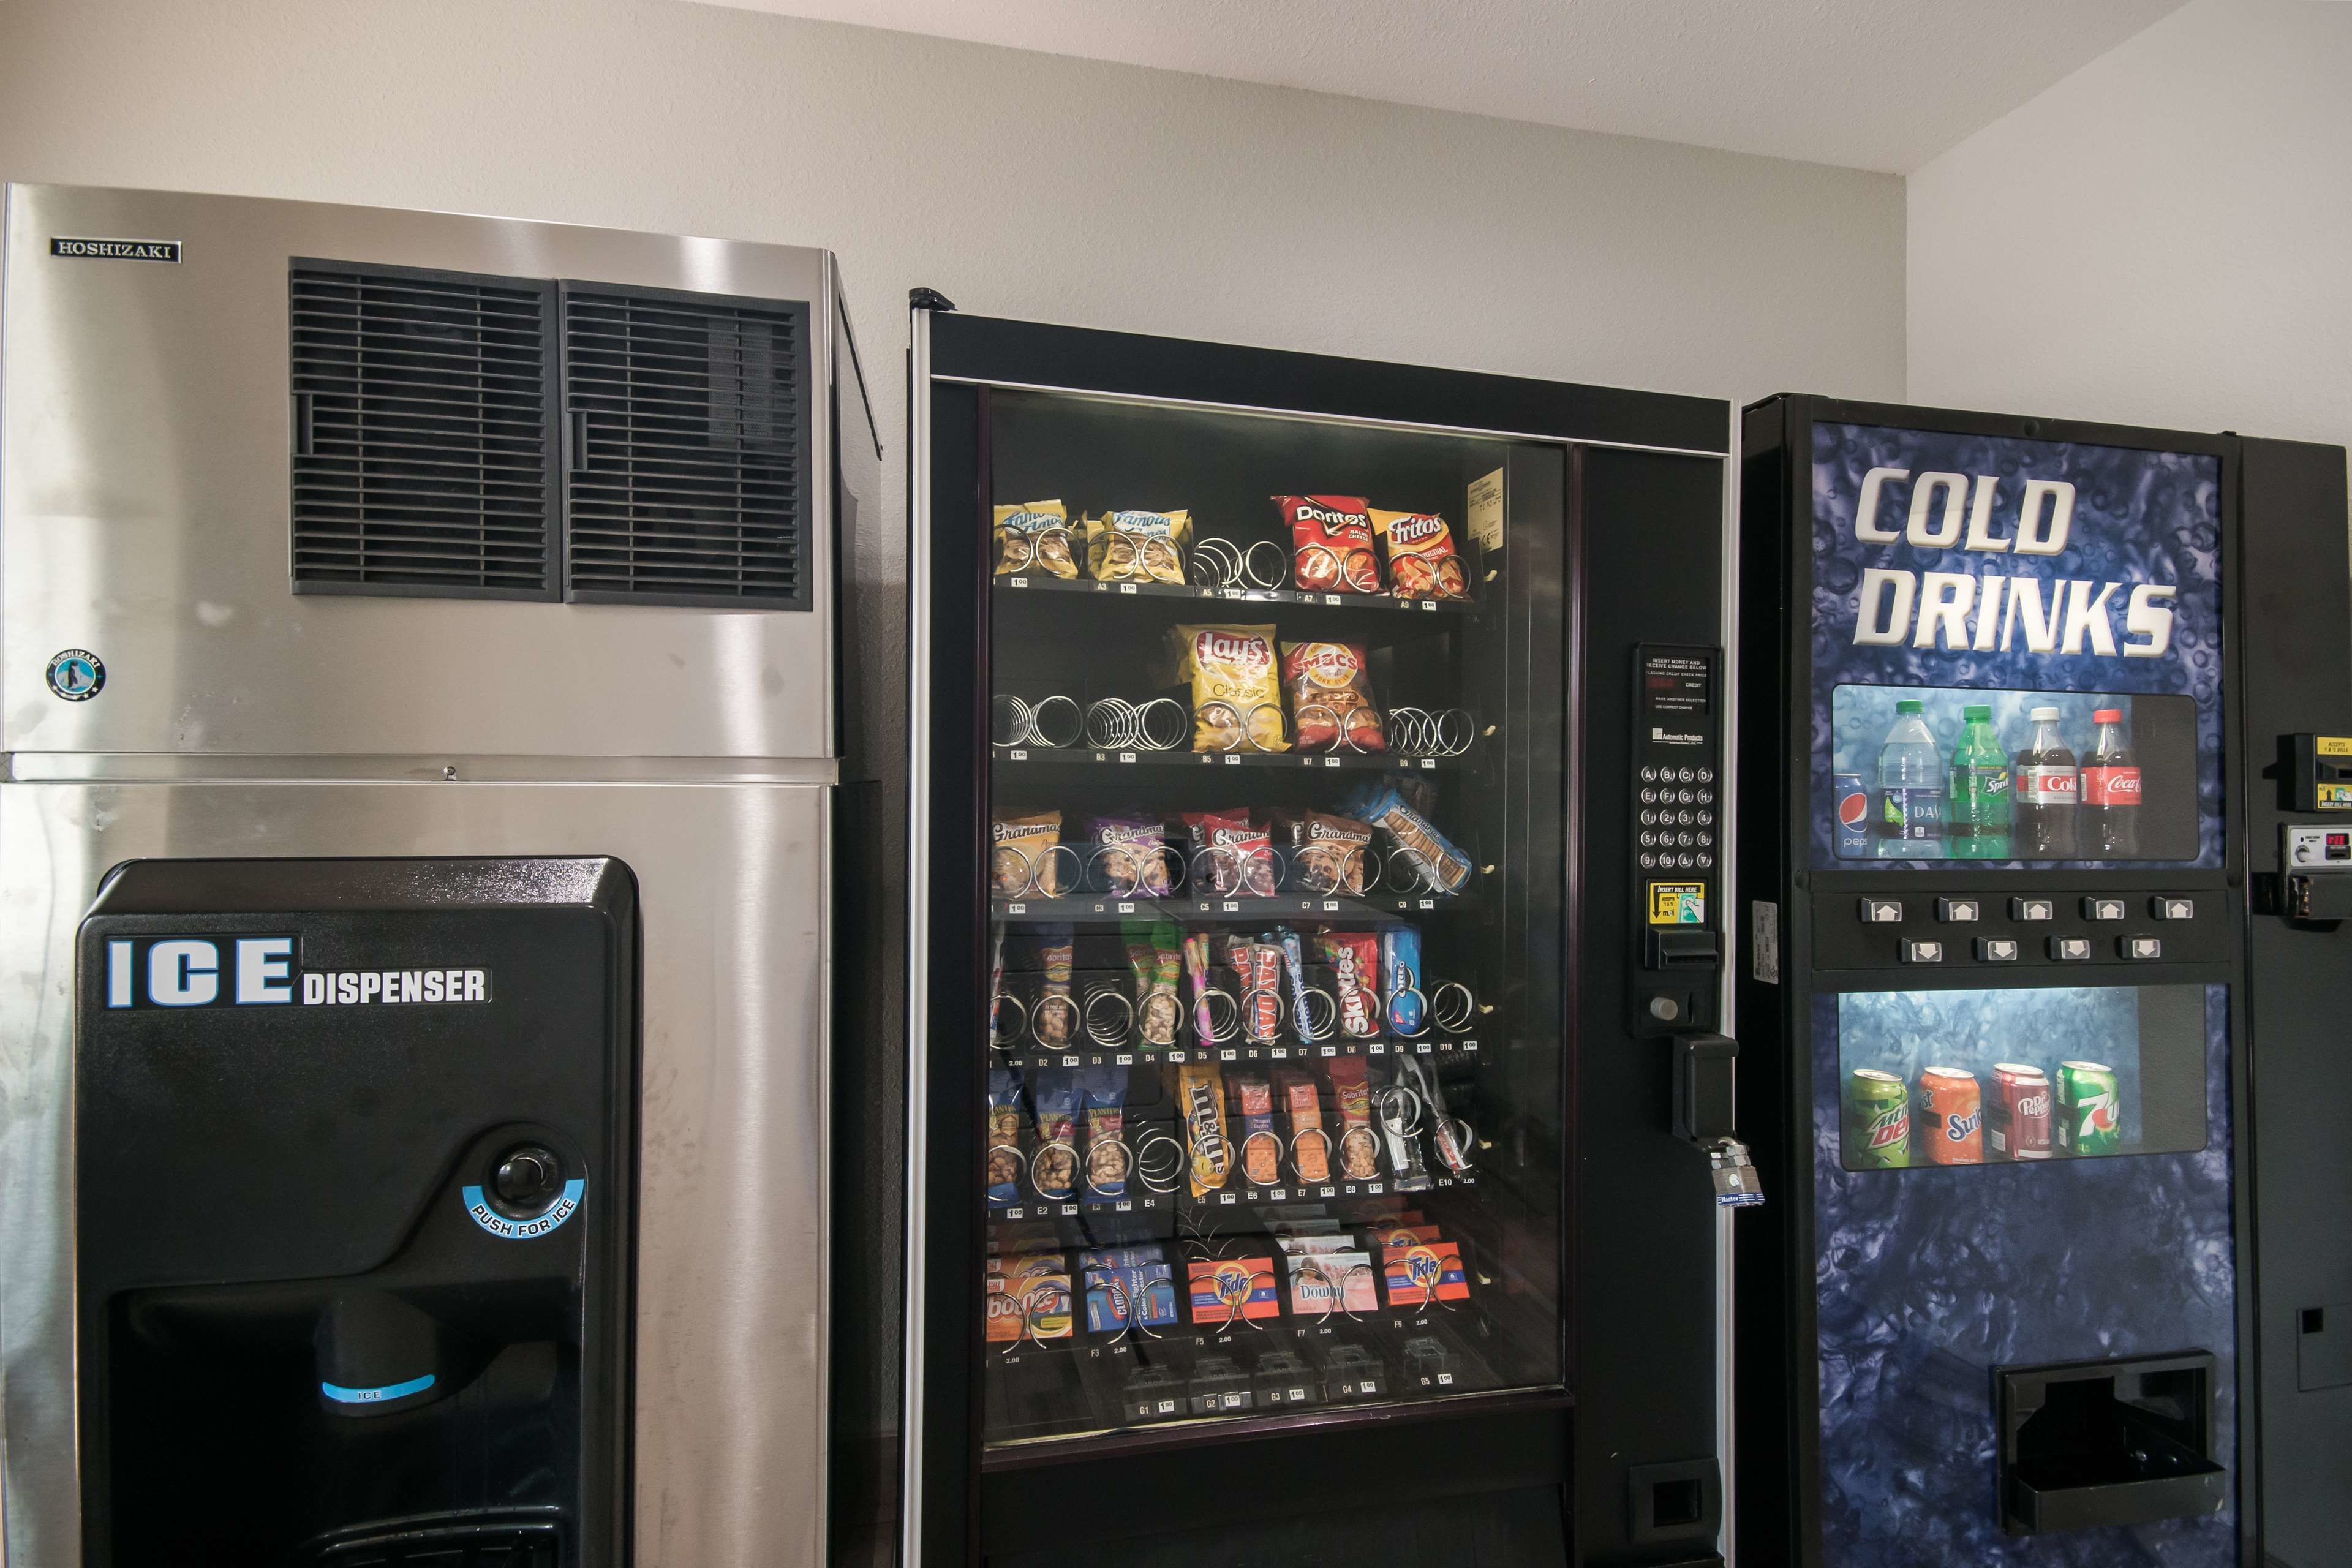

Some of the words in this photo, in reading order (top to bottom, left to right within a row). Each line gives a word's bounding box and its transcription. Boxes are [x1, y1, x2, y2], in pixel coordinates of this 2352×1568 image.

[58, 241, 171, 258] HOSHIZAKI
[1855, 467, 2076, 556] COLD
[1112, 510, 1170, 528] Famous
[1297, 505, 1366, 528] Doritos
[1387, 516, 1441, 544] Fritos
[1097, 582, 1107, 591] A3
[1304, 594, 1313, 603] A7
[1853, 568, 2177, 658] DRINKS
[1205, 632, 1262, 664] Lay's
[51, 650, 100, 668] HOSHIZAKI
[1213, 684, 1265, 699] Classic
[1096, 753, 1106, 761] B3
[1202, 755, 1212, 763] B5
[1645, 771, 1652, 779] A
[1664, 771, 1670, 779] B
[1682, 771, 1689, 780] C
[1700, 771, 1708, 780] D
[2047, 775, 2077, 791] Cok
[1645, 791, 1651, 800] E
[1664, 792, 1670, 801] F
[1682, 792, 1689, 801] G
[1700, 793, 1708, 801] H
[1664, 813, 1670, 822] 2
[1308, 821, 1372, 844] Grandma'
[1682, 835, 1688, 843] 7
[1700, 835, 1706, 843] 8
[1844, 837, 1867, 848] peps
[1645, 856, 1650, 865] 9
[1662, 856, 1671, 865] 10
[107, 938, 292, 1008] ICE
[302, 970, 485, 1005] DISPENSER
[1038, 1058, 1049, 1067] D2
[1092, 1057, 1102, 1065] D3
[1145, 1054, 1155, 1062] D4
[1947, 1107, 1981, 1142] Sunk
[1872, 1116, 1909, 1146] DE
[1346, 1185, 1356, 1194] E8
[1145, 1199, 1155, 1208] E4
[1197, 1196, 1206, 1204] E5
[1037, 1207, 1048, 1215] E2
[471, 1204, 513, 1235] PUSH
[517, 1218, 551, 1237] FOR
[552, 1198, 575, 1223] ICE
[1409, 1256, 1437, 1282] Tide
[1131, 1270, 1139, 1298] Fighter
[1218, 1272, 1250, 1300] Tide
[1394, 1320, 1403, 1329] F9
[1297, 1329, 1306, 1338] F7
[1091, 1349, 1100, 1357] F3
[1421, 1377, 1430, 1385] G5
[1343, 1385, 1352, 1394] G4
[358, 1390, 382, 1400] ICE
[1270, 1392, 1280, 1401] G3
